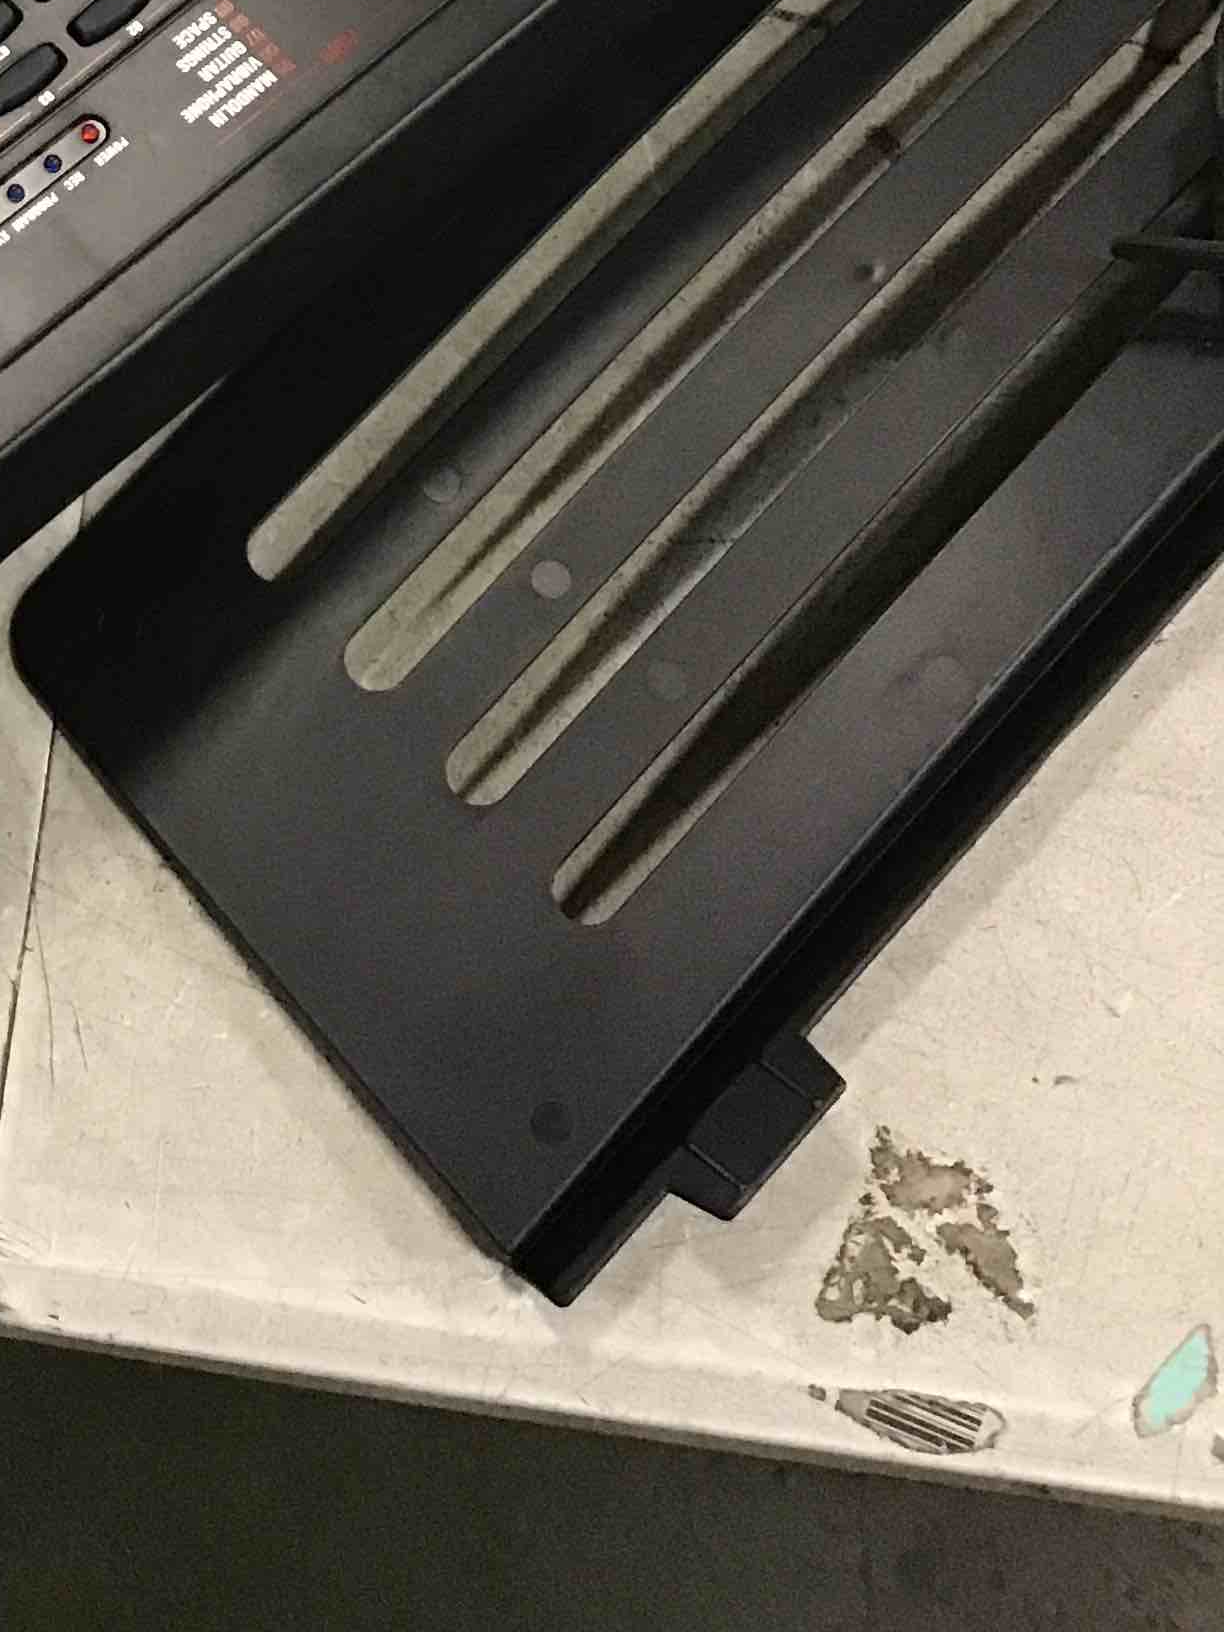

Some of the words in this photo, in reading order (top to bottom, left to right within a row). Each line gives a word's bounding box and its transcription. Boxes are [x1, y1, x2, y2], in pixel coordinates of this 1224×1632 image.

[171, 11, 218, 50] SPACE
[175, 26, 232, 73] STRINGS
[197, 40, 247, 83] GUITAR
[179, 56, 263, 124] VIBRAPHONE
[207, 69, 279, 128] MANDOLIN
[93, 136, 130, 167] POWER
[63, 171, 86, 191] REC
